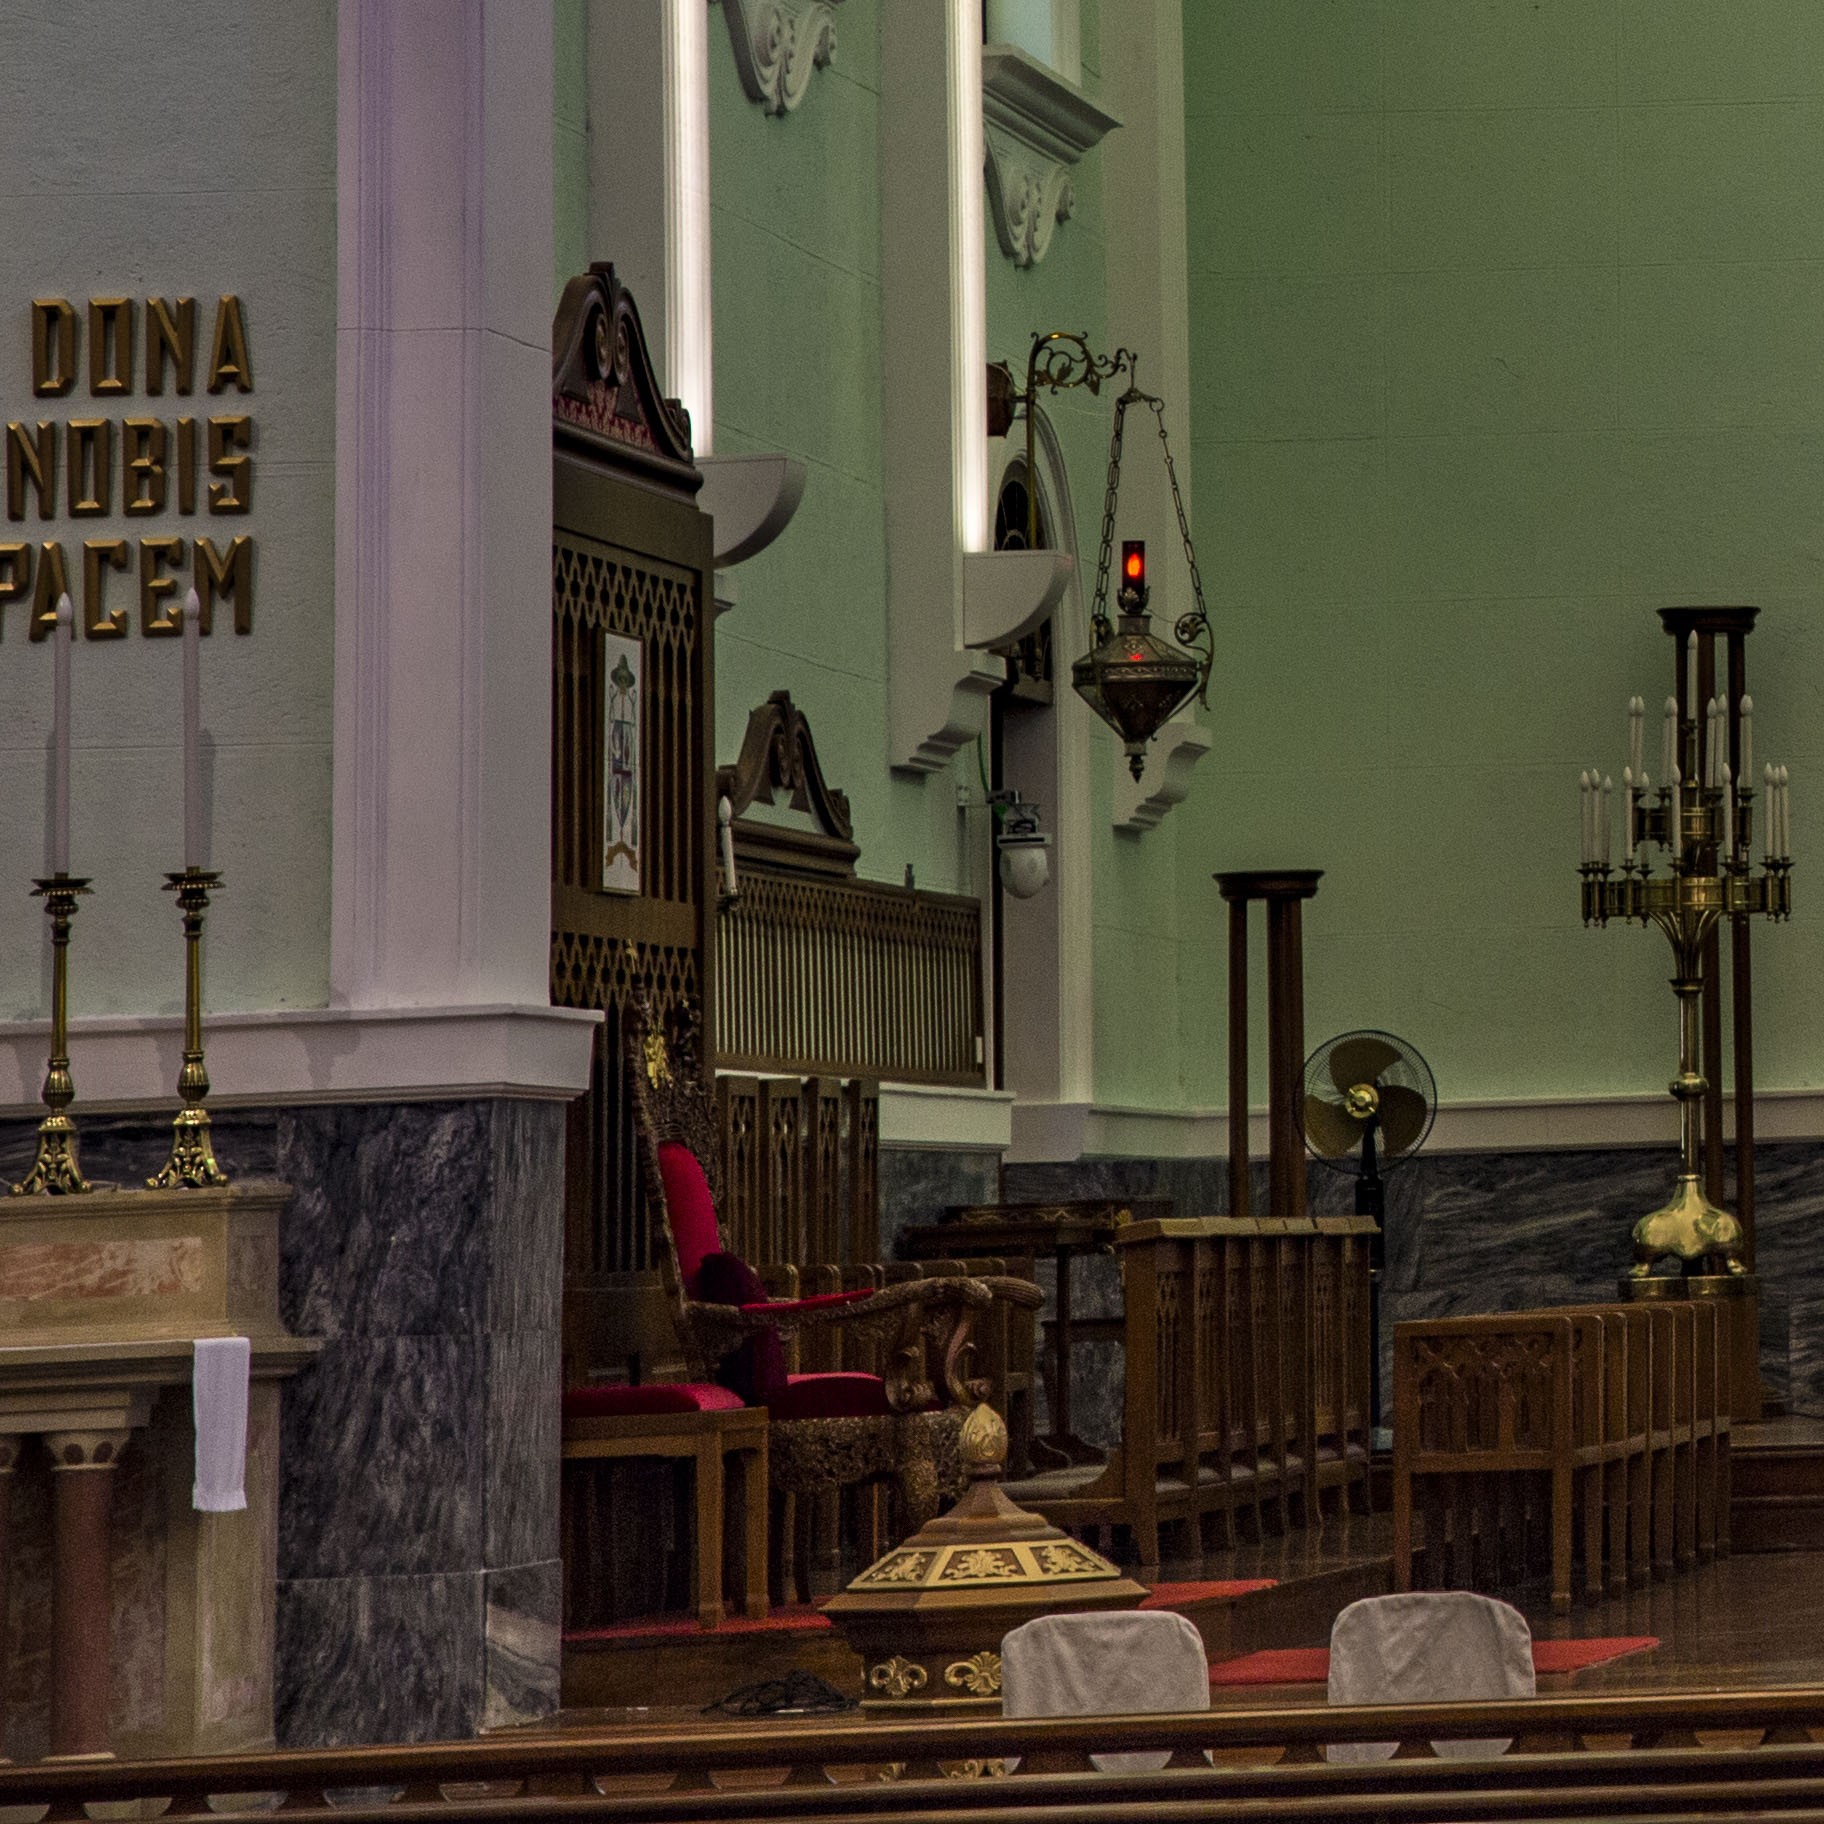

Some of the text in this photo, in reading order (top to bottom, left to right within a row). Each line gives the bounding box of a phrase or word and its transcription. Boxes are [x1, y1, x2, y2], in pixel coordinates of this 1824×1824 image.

[31, 295, 254, 398] DONA
[6, 415, 252, 522] NOBIS
[0, 534, 254, 643] PACEM
